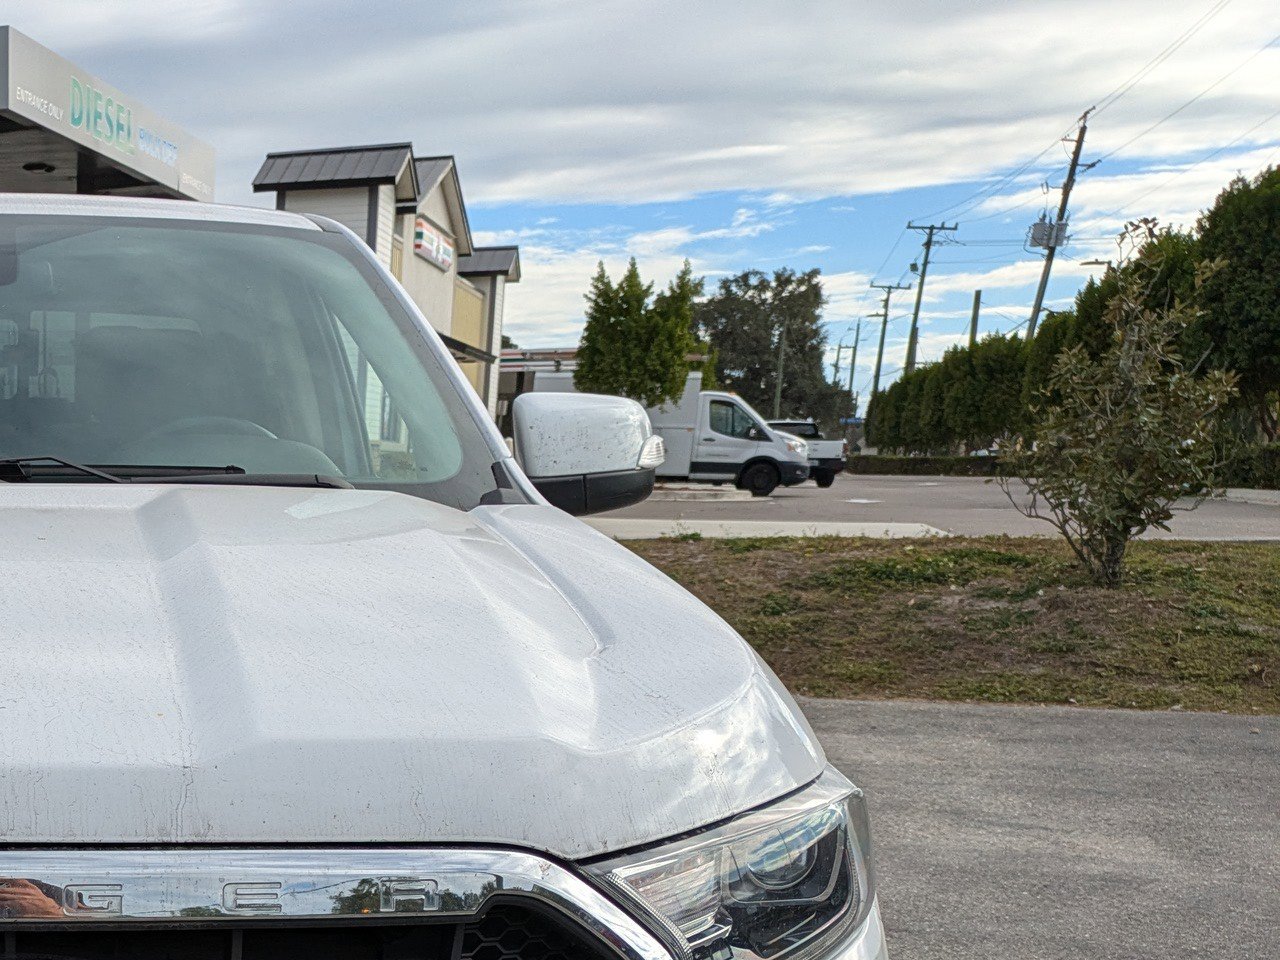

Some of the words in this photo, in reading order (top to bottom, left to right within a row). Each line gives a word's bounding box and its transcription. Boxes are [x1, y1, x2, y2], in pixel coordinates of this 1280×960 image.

[16, 86, 48, 113] ENTRANCE
[48, 103, 64, 121] ONLY
[70, 75, 136, 156] DIESEL
